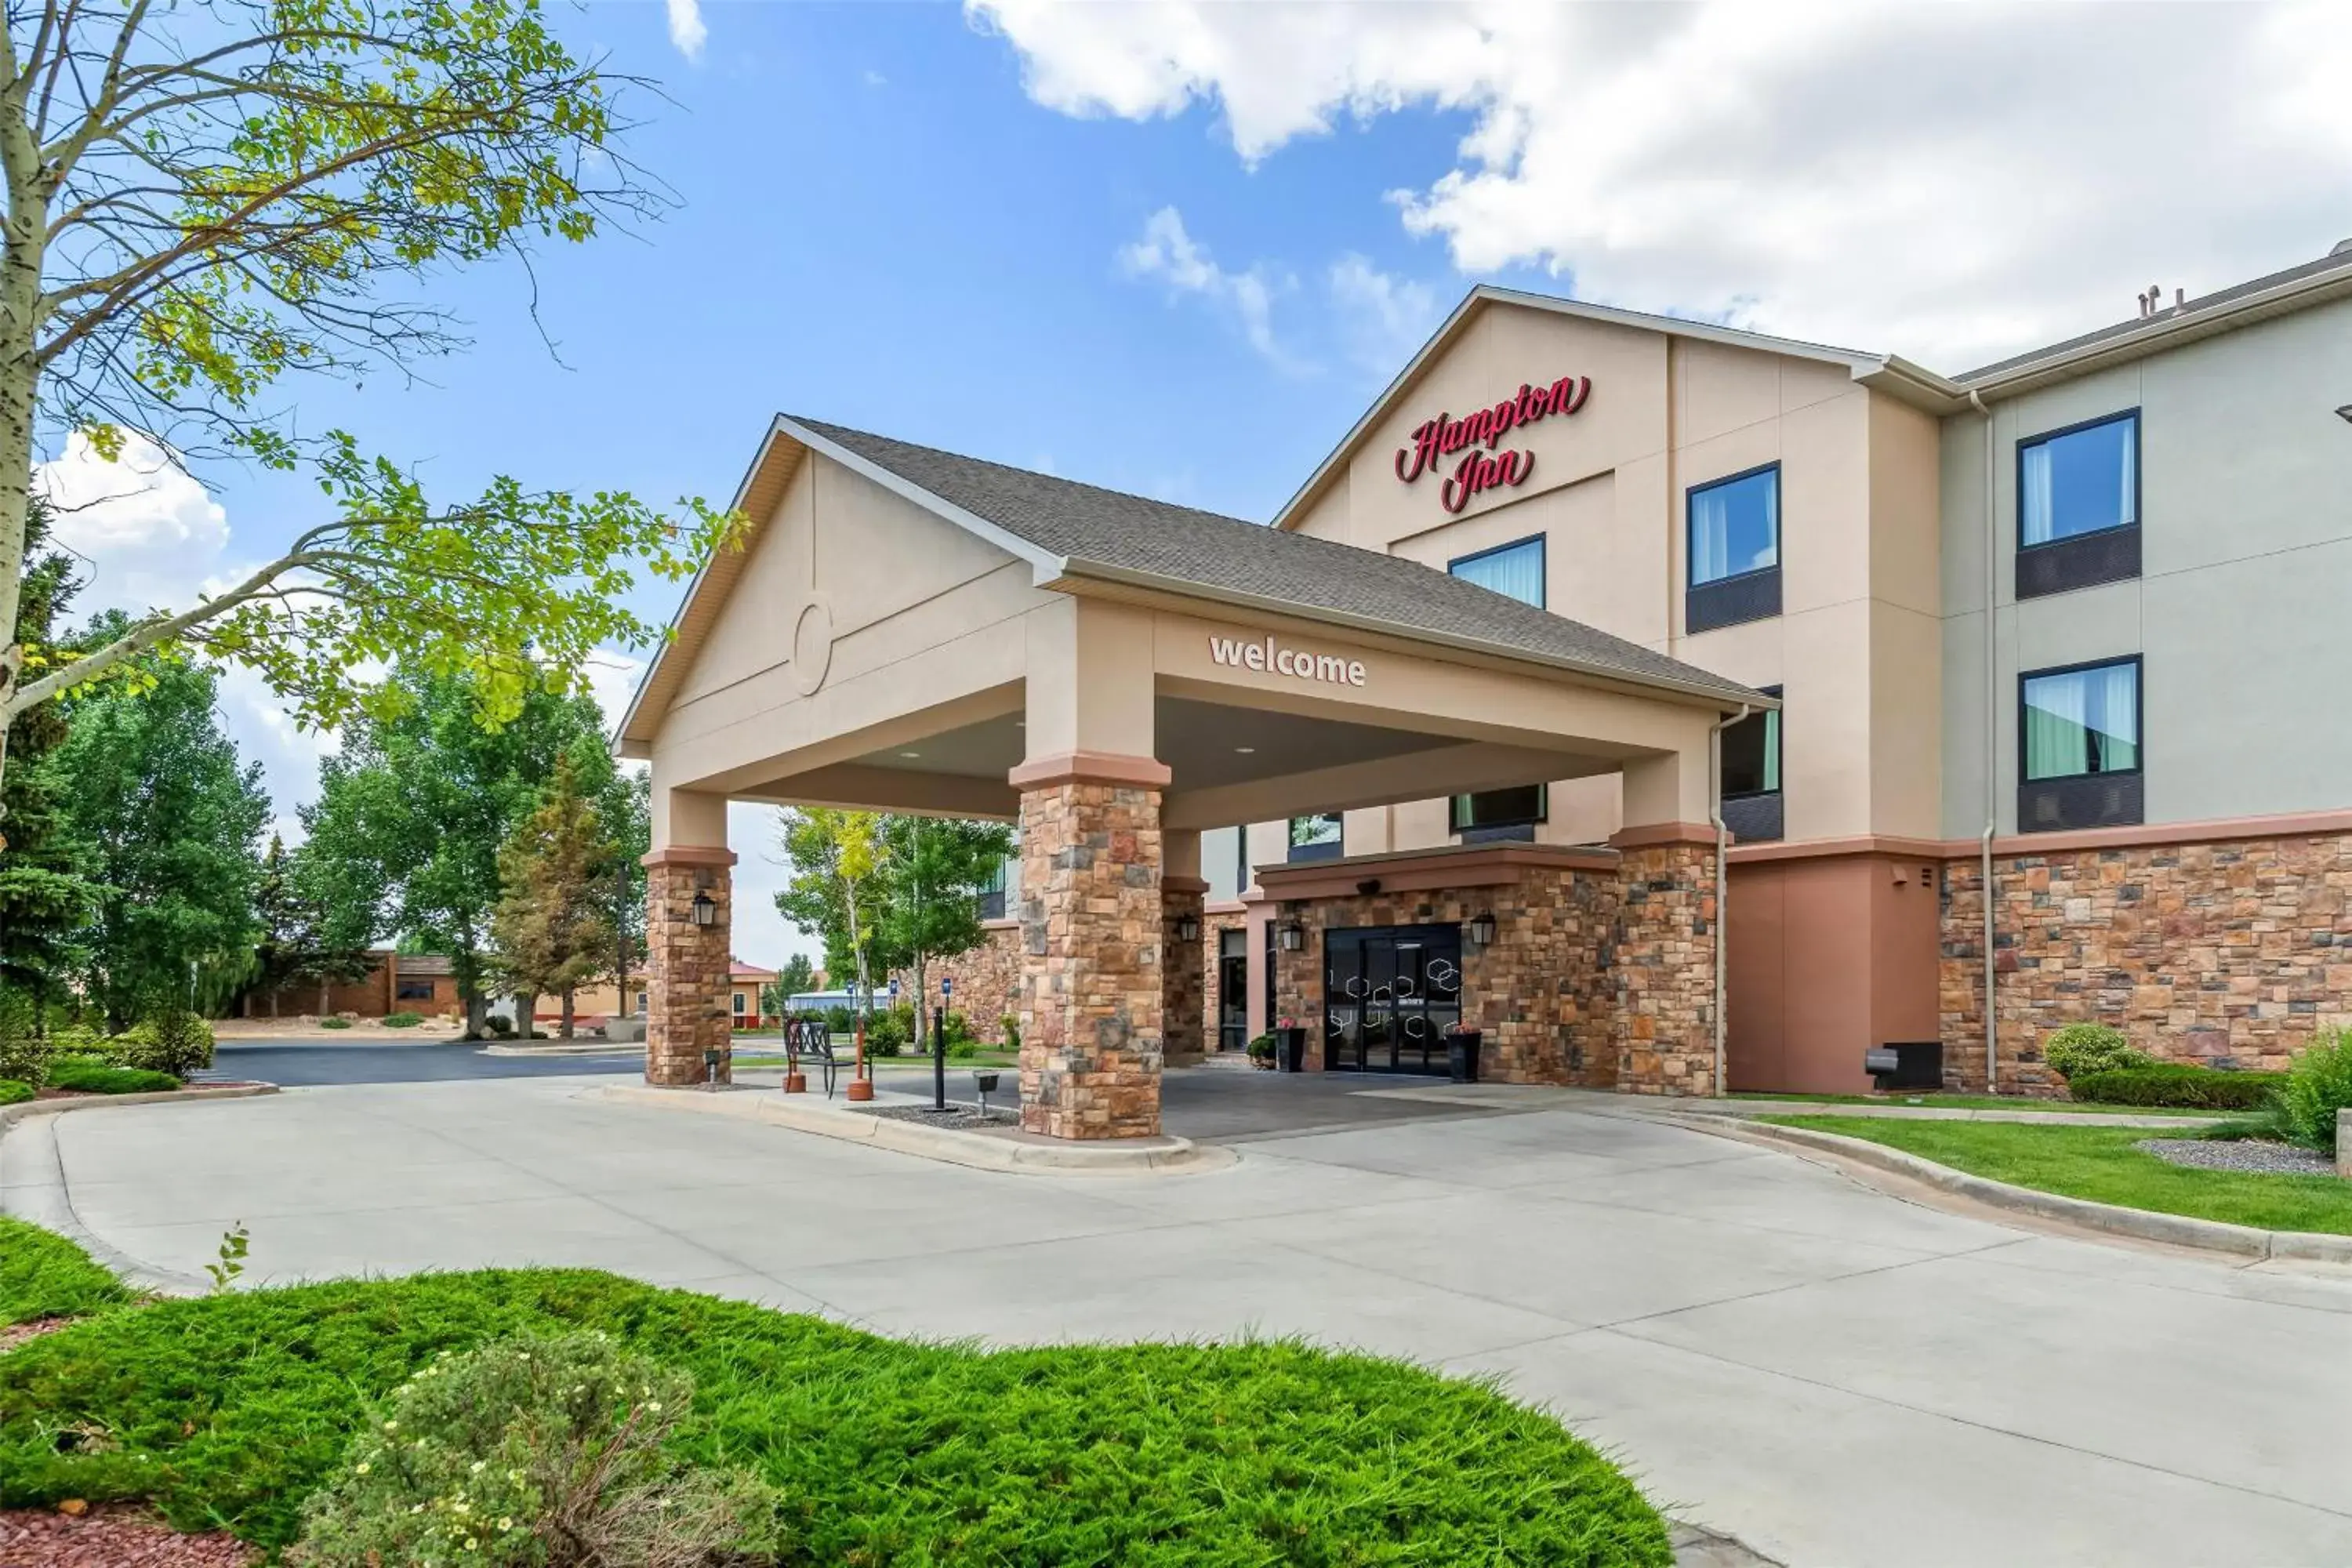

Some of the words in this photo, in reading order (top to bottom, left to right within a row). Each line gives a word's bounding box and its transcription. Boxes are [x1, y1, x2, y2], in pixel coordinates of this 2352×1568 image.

[1395, 376, 1592, 484] Hampton
[1441, 449, 1535, 514] Inn
[1209, 634, 1367, 687] welcome
